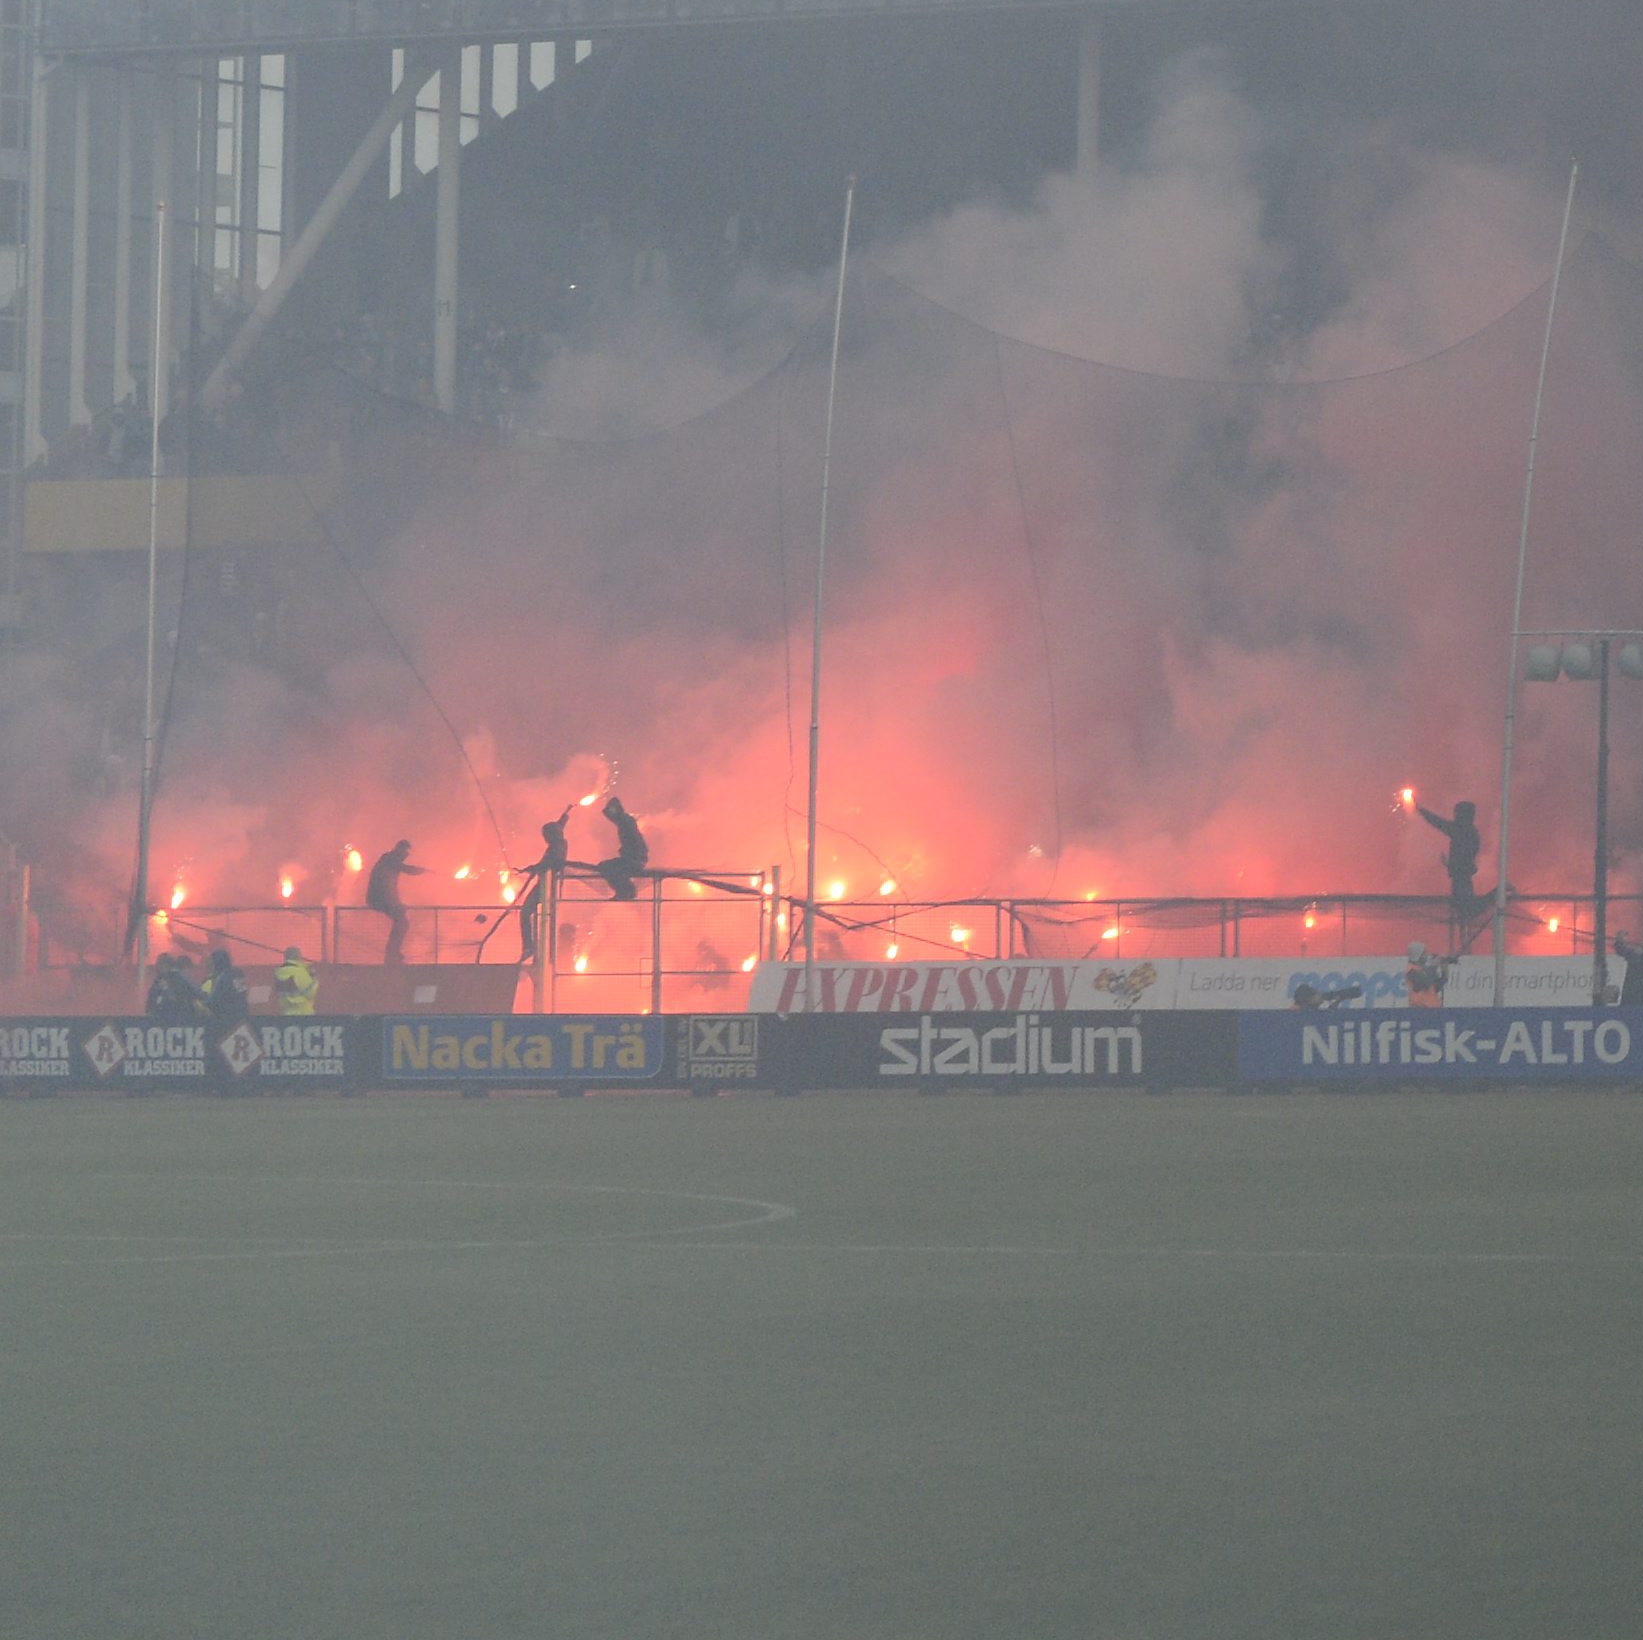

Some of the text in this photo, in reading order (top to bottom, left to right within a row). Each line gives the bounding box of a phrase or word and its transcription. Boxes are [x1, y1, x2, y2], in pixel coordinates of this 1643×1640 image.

[776, 966, 1079, 1012] EXPRESSEN
[1190, 971, 1245, 991] Ladda
[1250, 975, 1279, 991] ner
[1287, 971, 1408, 1008] moppe
[124, 1026, 205, 1058] ROCK
[260, 1026, 344, 1058] ROCK
[391, 1021, 645, 1070] Nacka Trä
[879, 1014, 1141, 1075] stadium
[1302, 1020, 1631, 1065] Nilfisk-ALTO
[124, 1059, 205, 1076] KLASSIKER
[260, 1059, 344, 1076] KLASSIKER
[690, 1062, 758, 1079] PROFFS
